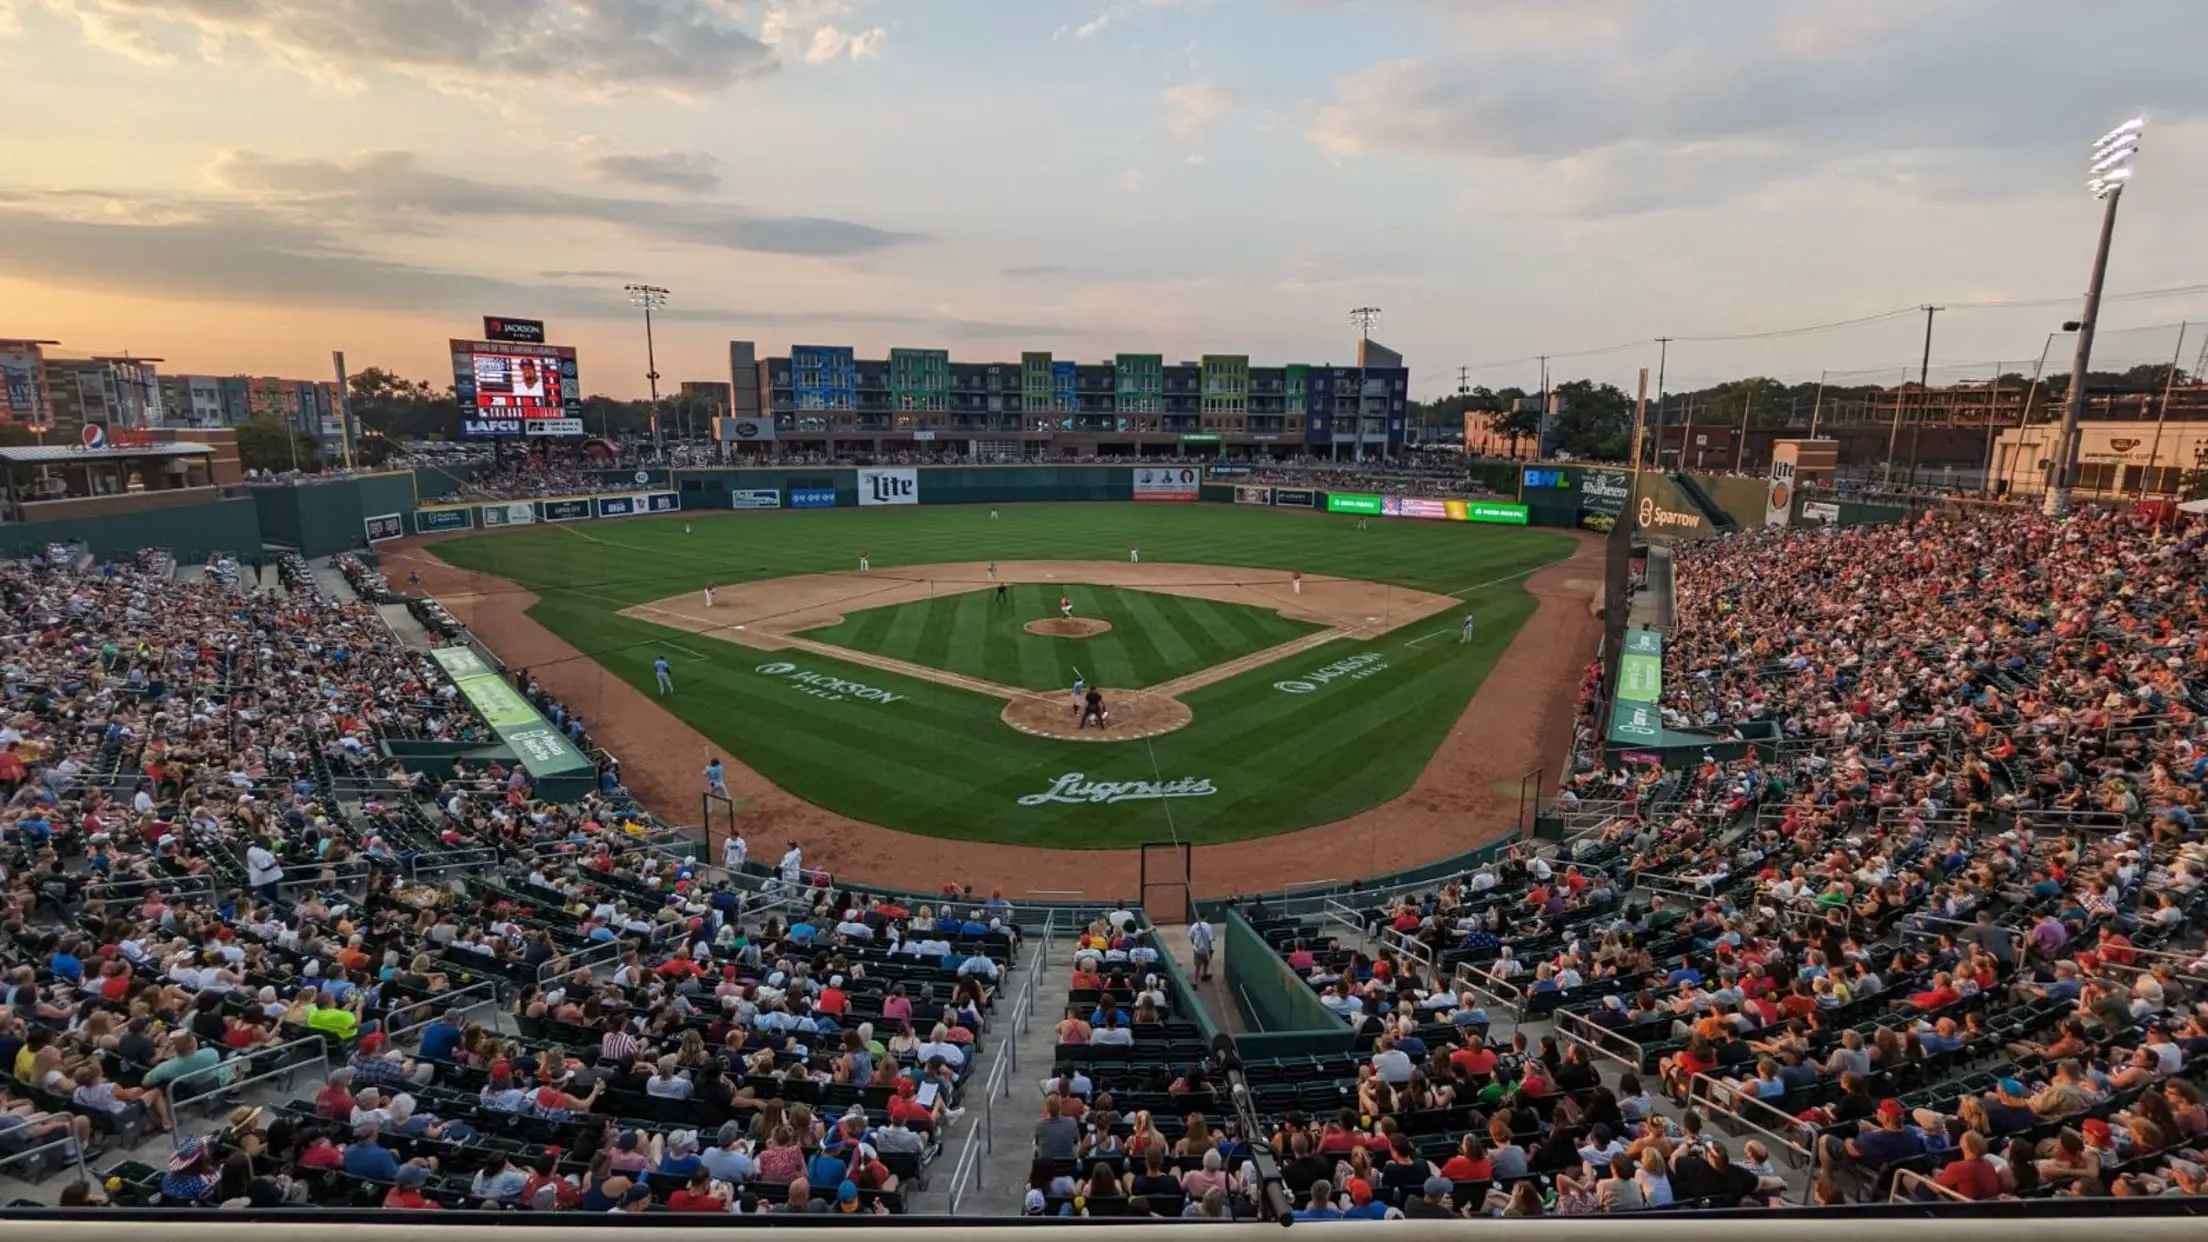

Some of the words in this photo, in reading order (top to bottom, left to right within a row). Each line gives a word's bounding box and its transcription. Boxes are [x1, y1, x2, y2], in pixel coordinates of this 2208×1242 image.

[504, 323, 540, 333] JACKSON
[465, 420, 519, 431] LAFCU
[1523, 470, 1570, 488] BWL
[1773, 461, 1795, 481] Lite
[870, 474, 913, 502] Lite
[1581, 480, 1628, 498] Shaheen
[1654, 506, 1700, 528] Sparrow
[1301, 652, 1384, 684] JACKSON
[788, 671, 904, 704] JACKSON
[1017, 772, 1218, 805] Lugnuts
